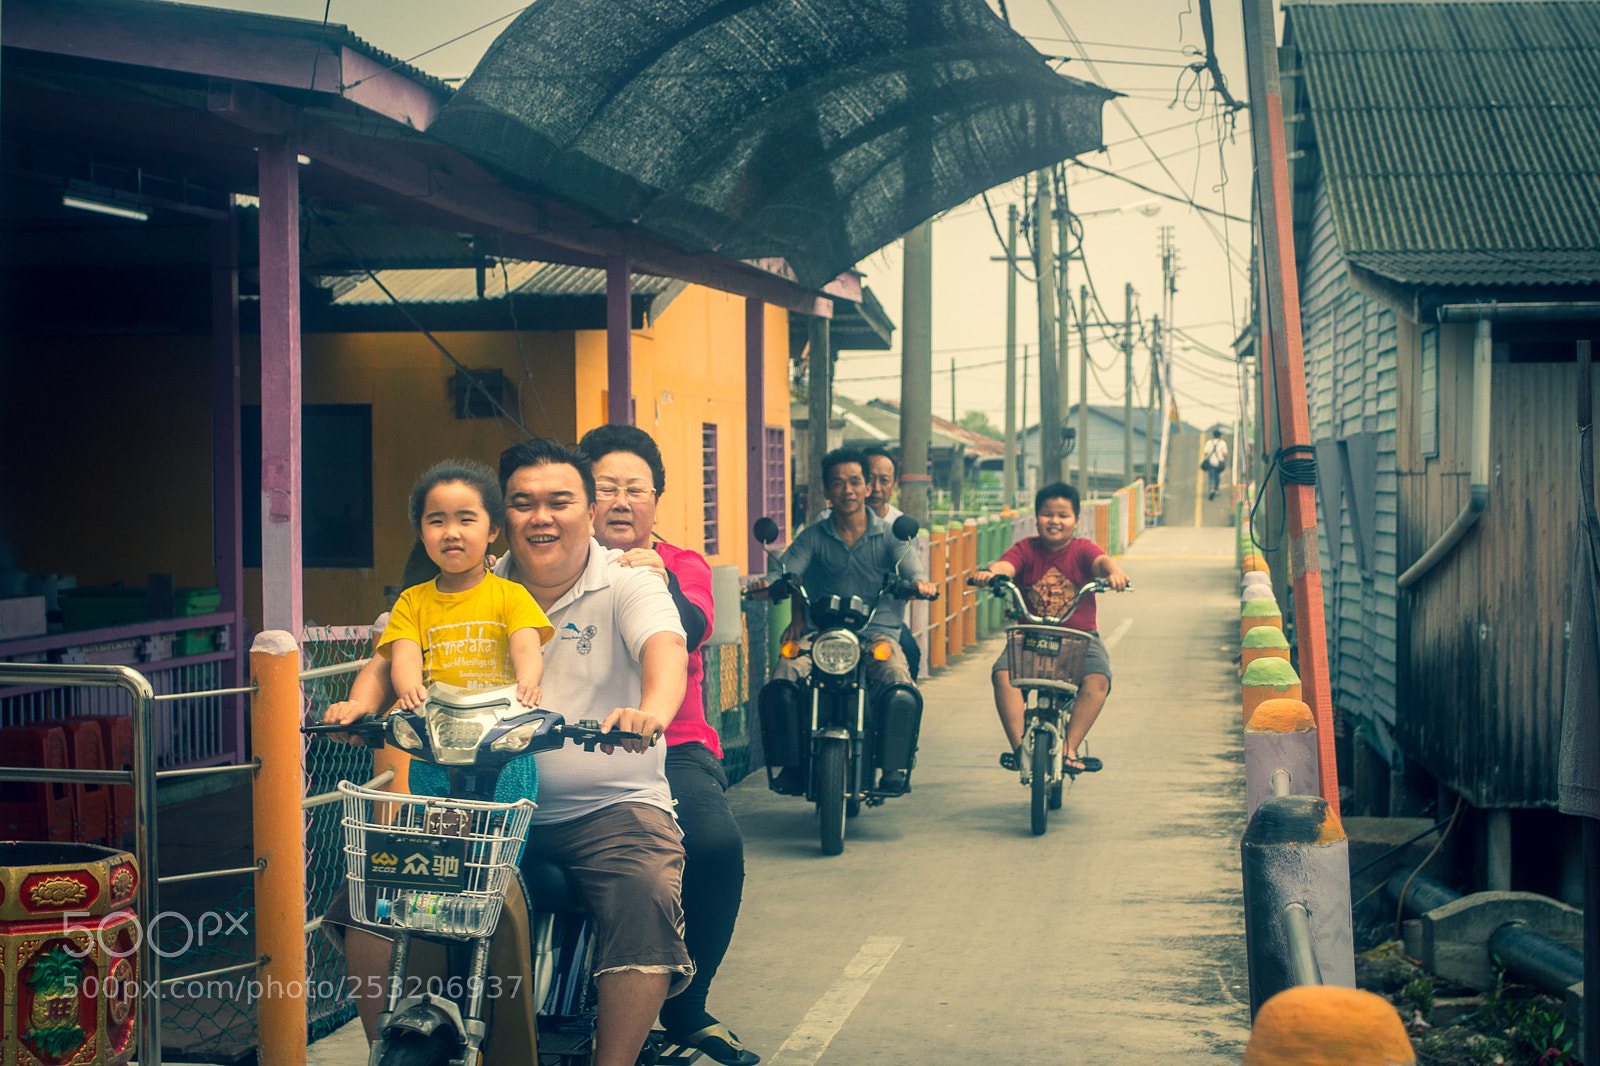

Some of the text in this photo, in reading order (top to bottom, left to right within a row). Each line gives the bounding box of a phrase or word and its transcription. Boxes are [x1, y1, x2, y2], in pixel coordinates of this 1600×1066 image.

[445, 626, 492, 656] melaka
[443, 657, 461, 669] world
[462, 656, 487, 669] heritage
[401, 852, 460, 878] 众驰
